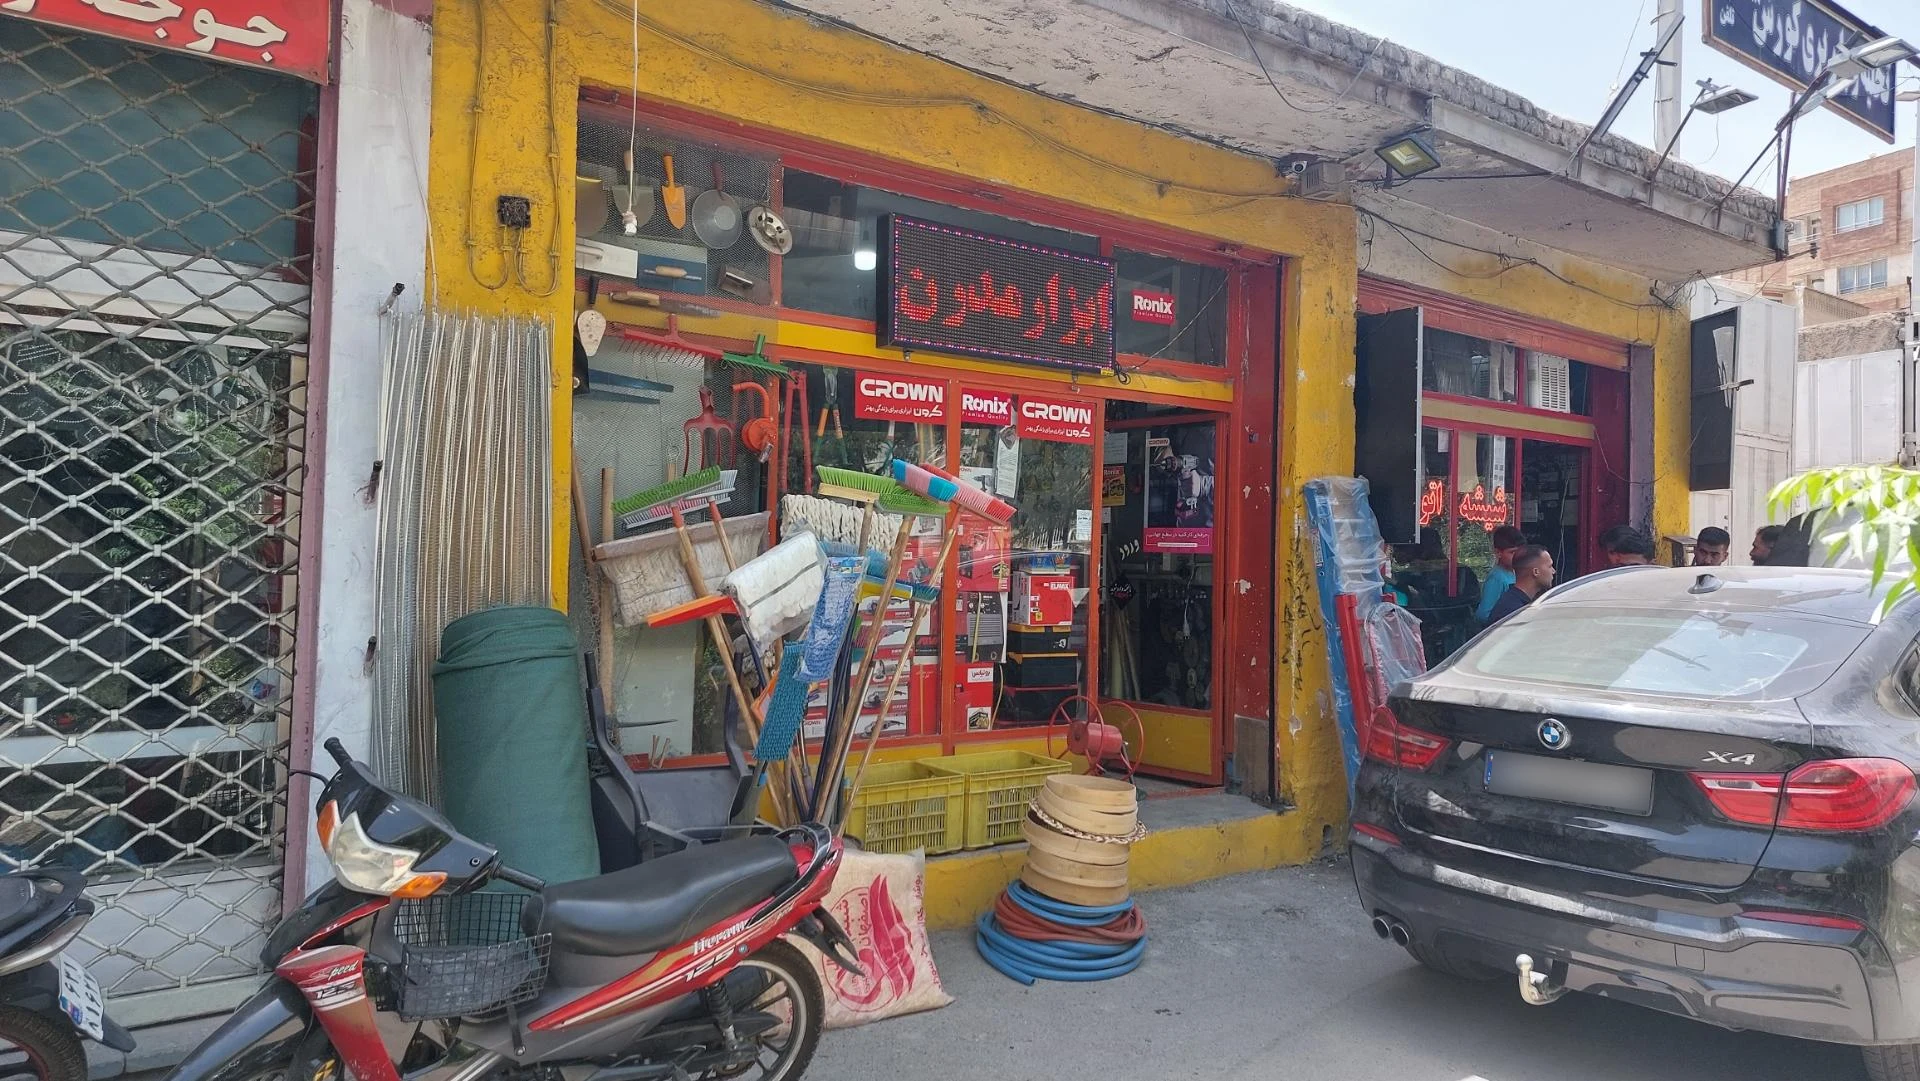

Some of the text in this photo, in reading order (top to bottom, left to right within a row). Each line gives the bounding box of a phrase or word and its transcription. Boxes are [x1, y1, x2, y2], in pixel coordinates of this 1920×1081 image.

[1022, 272, 1110, 347] ابزار
[1133, 295, 1173, 315] Ronix
[860, 378, 943, 403] CROWN
[913, 404, 943, 418] کرون
[962, 394, 1008, 415] Ronix
[1022, 401, 1092, 424] CROWN
[1065, 426, 1091, 438] کرون
[1459, 484, 1507, 531] شیشه
[1119, 539, 1140, 561] ورود
[1702, 750, 1755, 765] X4
[857, 892, 872, 947] اصفهان
[685, 946, 736, 982] 125
[316, 980, 356, 1000] 125
